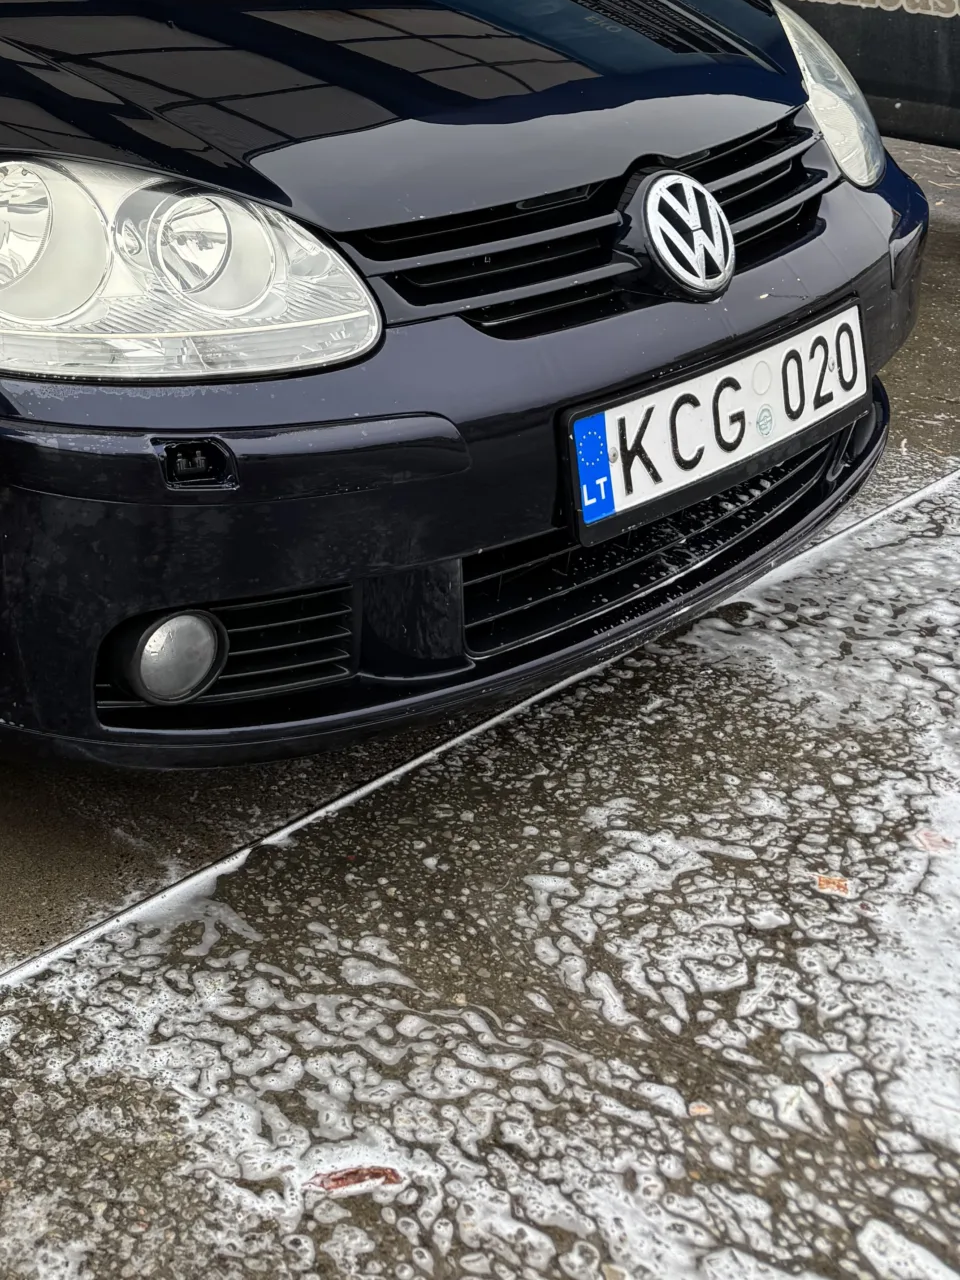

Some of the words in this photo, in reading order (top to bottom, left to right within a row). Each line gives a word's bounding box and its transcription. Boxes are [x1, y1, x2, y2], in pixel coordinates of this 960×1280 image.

[616, 375, 747, 497] KCG
[781, 321, 858, 422] 020
[580, 475, 608, 507] LT
